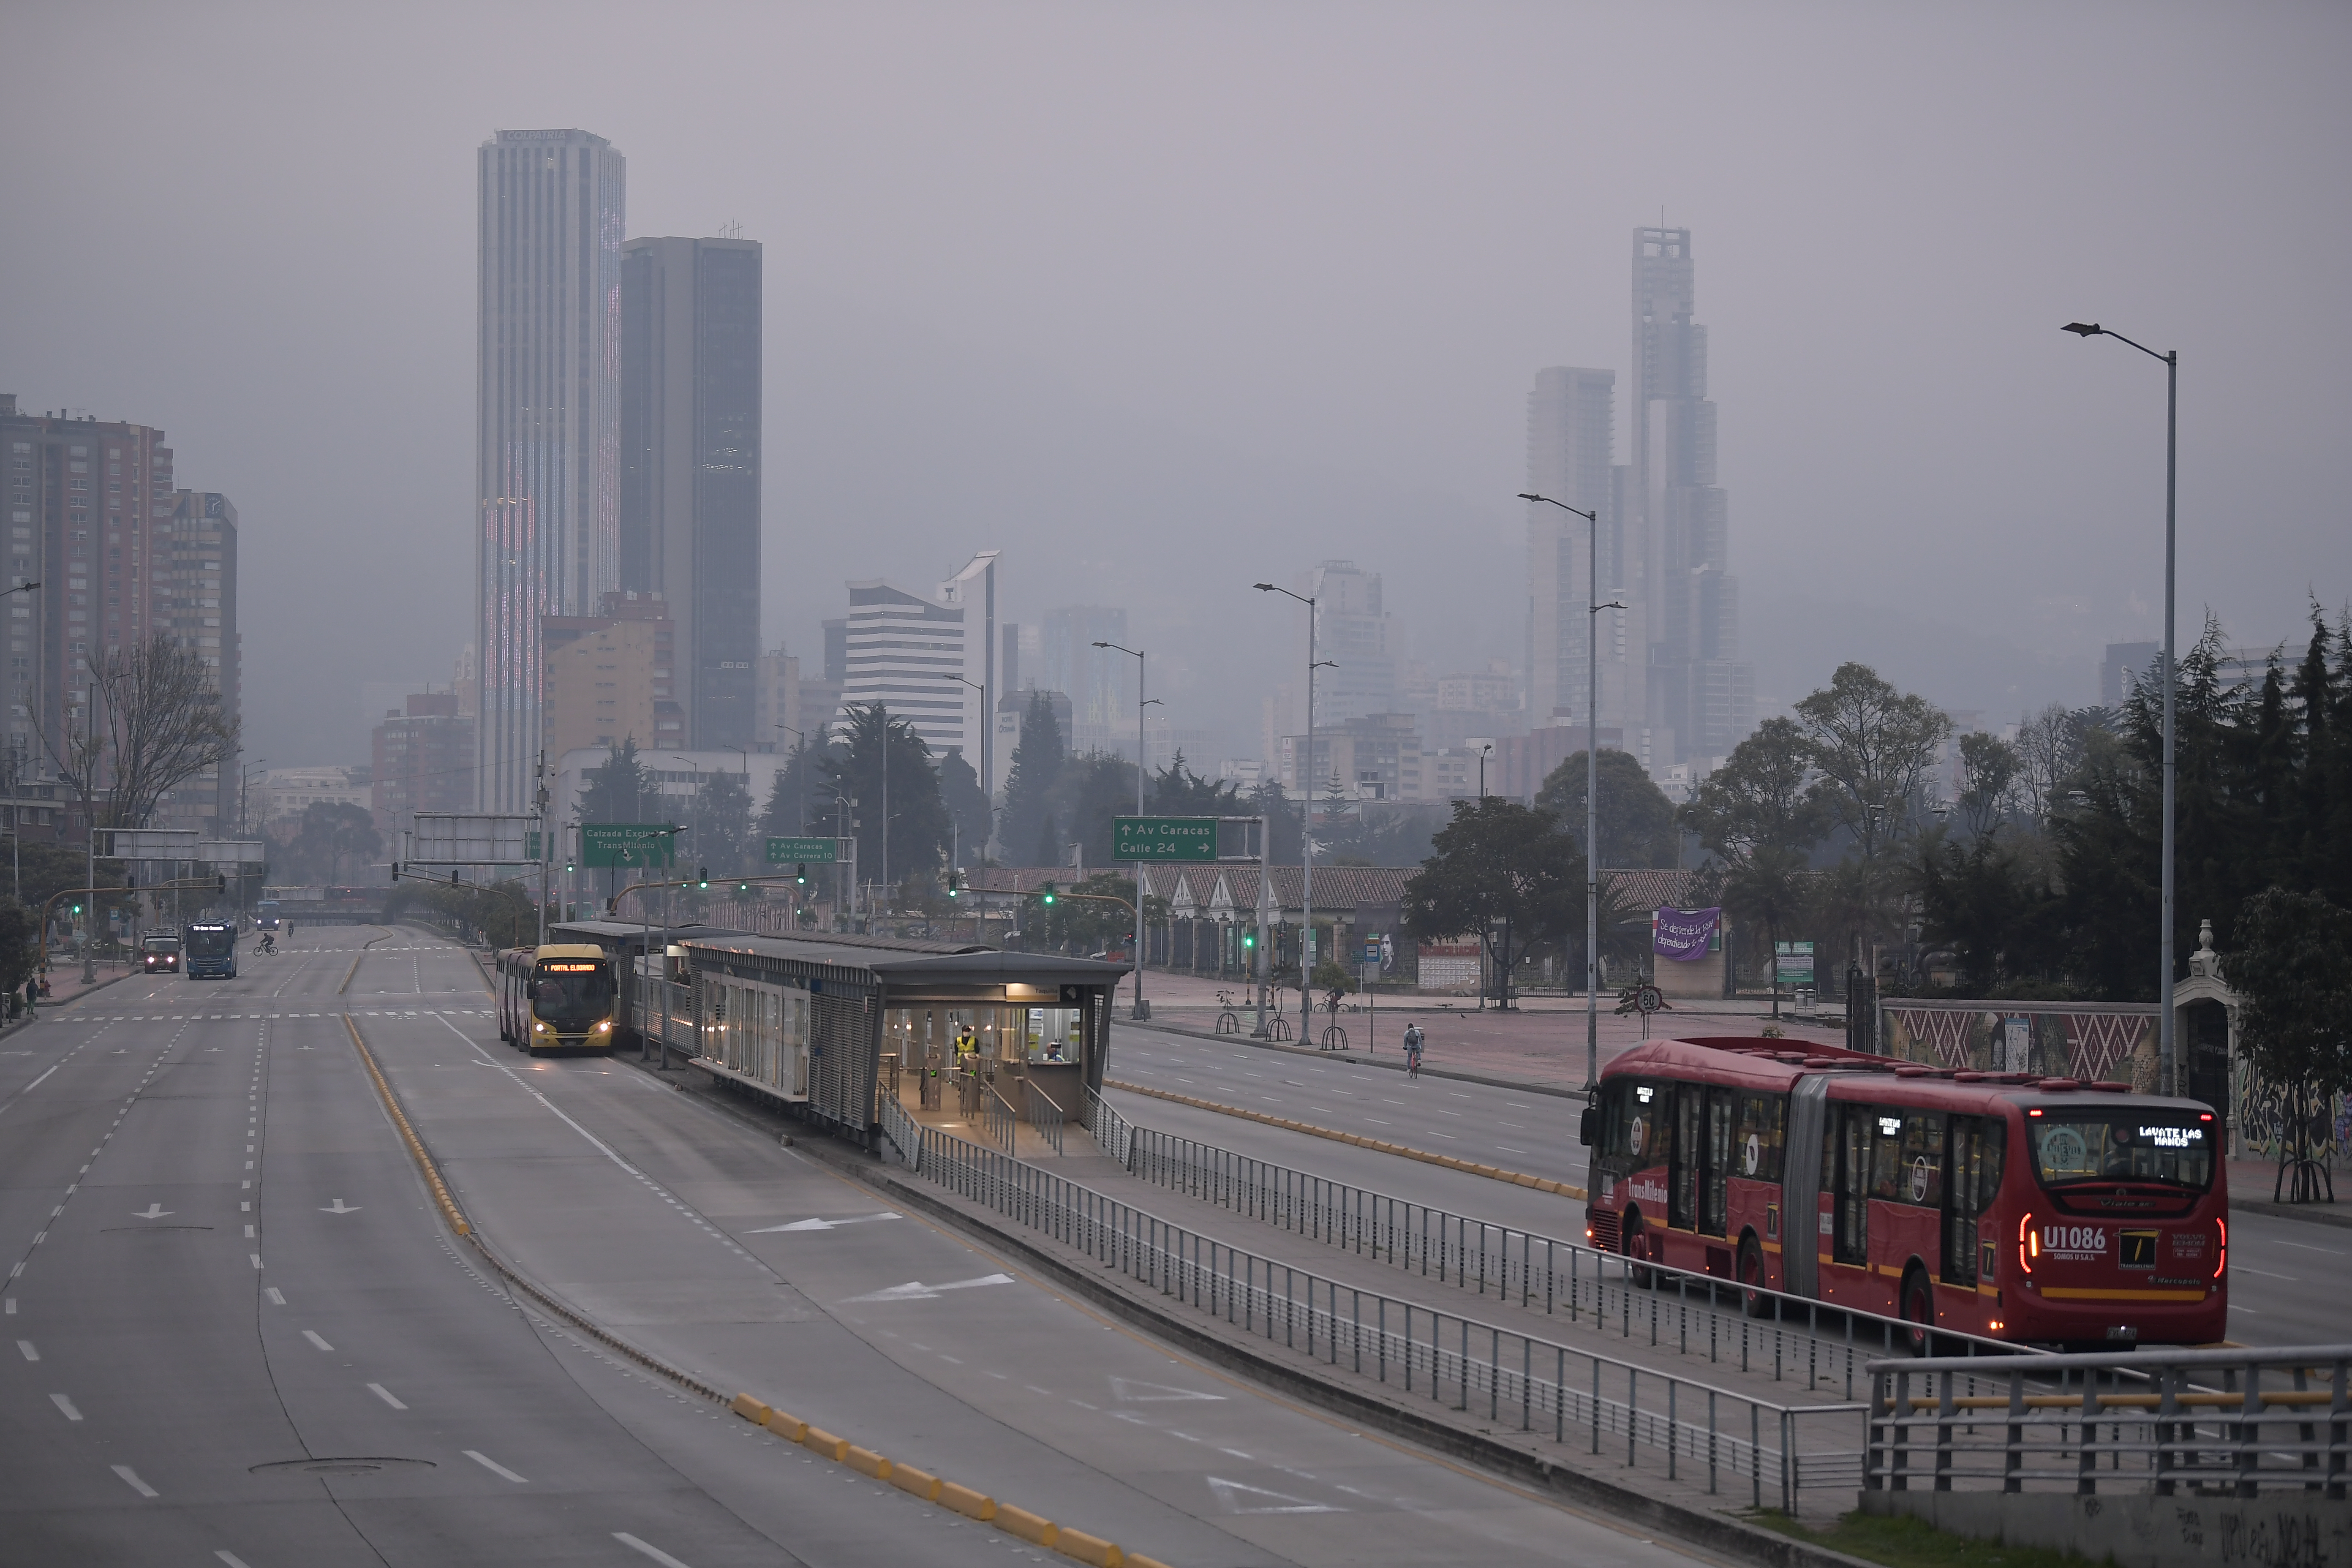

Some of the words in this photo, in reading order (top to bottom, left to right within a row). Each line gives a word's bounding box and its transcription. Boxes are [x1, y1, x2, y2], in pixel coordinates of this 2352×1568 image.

[507, 130, 566, 140] COLPATRIA
[1137, 825, 1154, 834] Av
[1160, 825, 1209, 835] Caracas
[1121, 843, 1151, 852] Calle
[1157, 843, 1176, 852] 24
[1660, 919, 1668, 931] Se
[1695, 925, 1701, 934] la
[1644, 994, 1654, 1006] 60
[2140, 1126, 2180, 1137] LAVATE
[2182, 1128, 2202, 1139] LAS
[2154, 1136, 2188, 1147] MANOS
[1628, 1177, 1668, 1203] TransMilenio
[2044, 1226, 2106, 1249] U1086
[2157, 1277, 2201, 1285] Marcopolo
